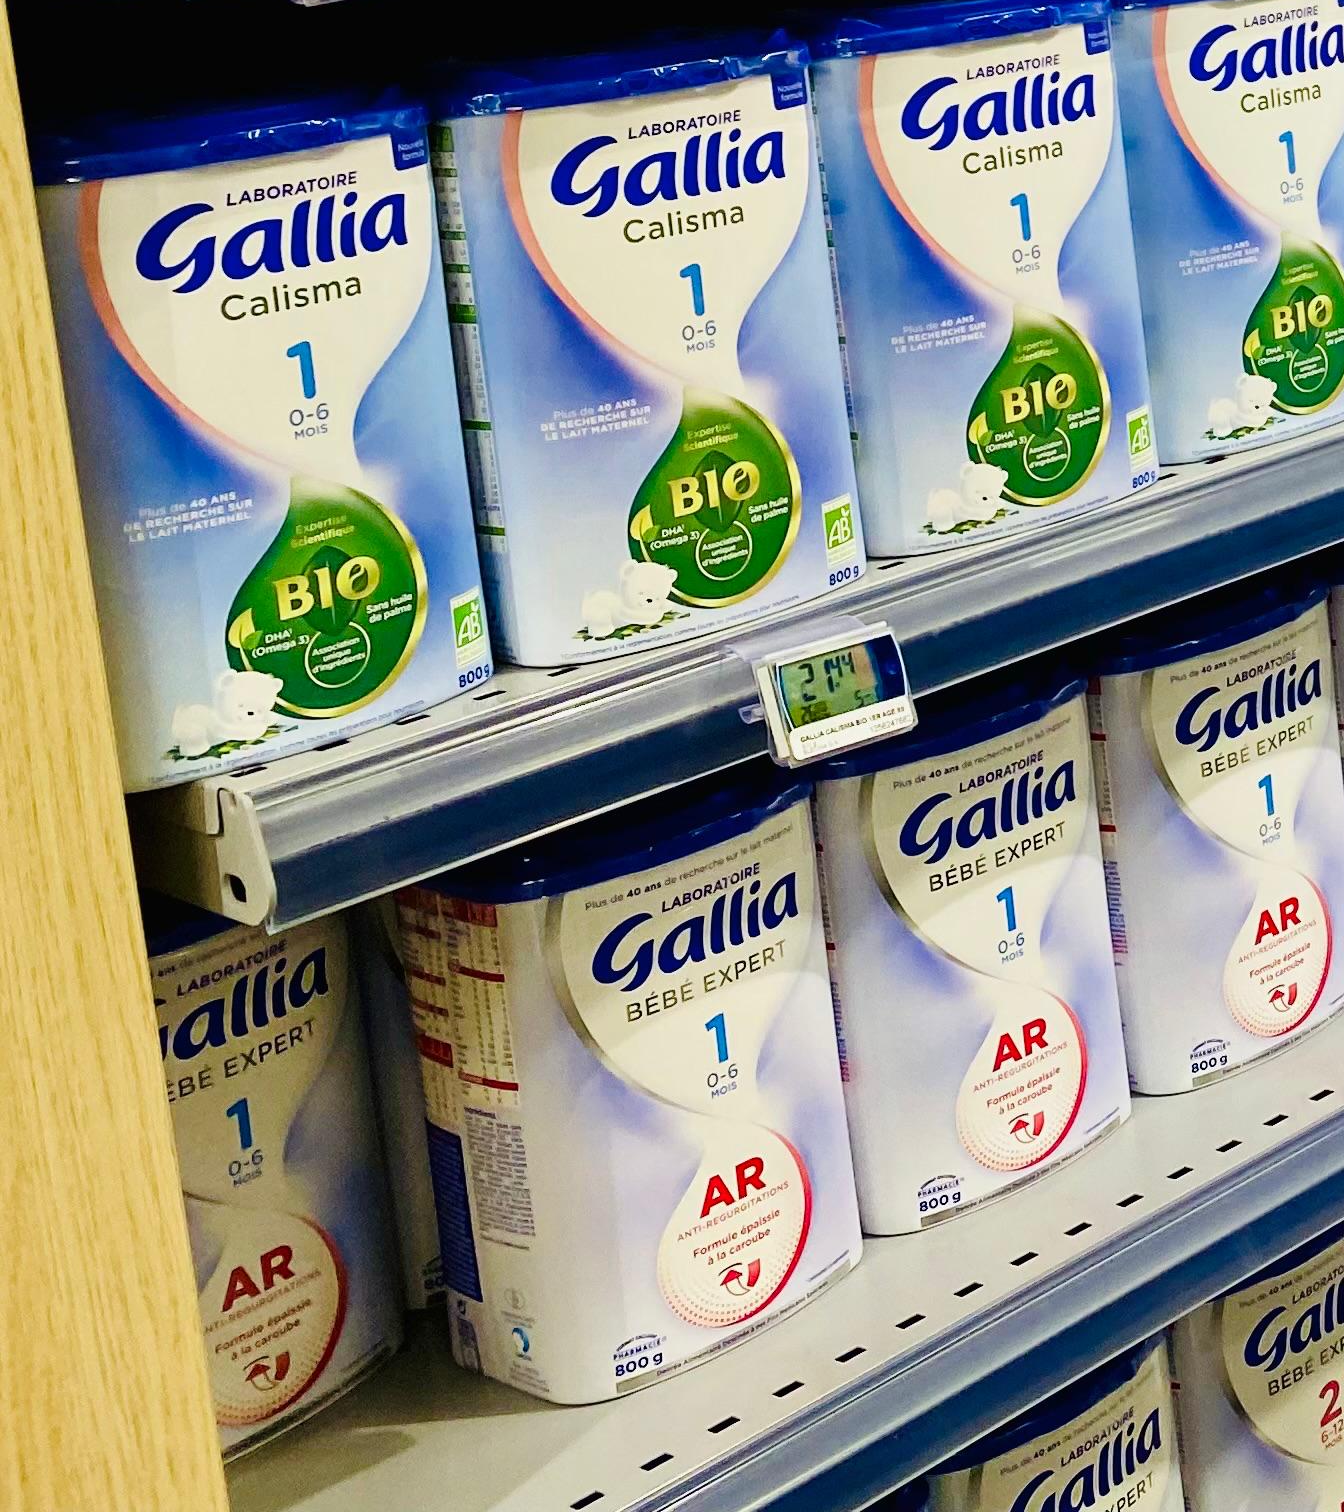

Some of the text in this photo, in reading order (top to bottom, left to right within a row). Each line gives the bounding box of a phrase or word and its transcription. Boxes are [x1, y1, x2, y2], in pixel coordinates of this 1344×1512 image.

[900, 71, 1096, 150] Gallia
[226, 172, 357, 207] LABORATOIRE
[550, 129, 786, 218] Gallia
[135, 193, 408, 294] Gallia
[220, 276, 362, 321] Calisma
[287, 340, 315, 398] 1
[289, 404, 329, 427] 0-6
[667, 460, 760, 518] BIO
[273, 555, 380, 617] BIO
[455, 603, 481, 645] AB
[899, 759, 1077, 865] Gallia
[929, 821, 1066, 893] BÉBÉ EXPERT
[662, 863, 761, 913] LABORATOIRE
[591, 872, 799, 992] Gallia
[626, 940, 786, 1022] BÉBÉ EXPERT
[705, 1013, 730, 1063] 1
[992, 1019, 1049, 1072] AR
[699, 1157, 766, 1219] AR
[693, 1208, 781, 1259] Formule épaissie
[730, 1227, 771, 1256] caroube
[615, 1353, 663, 1377] 800 g
